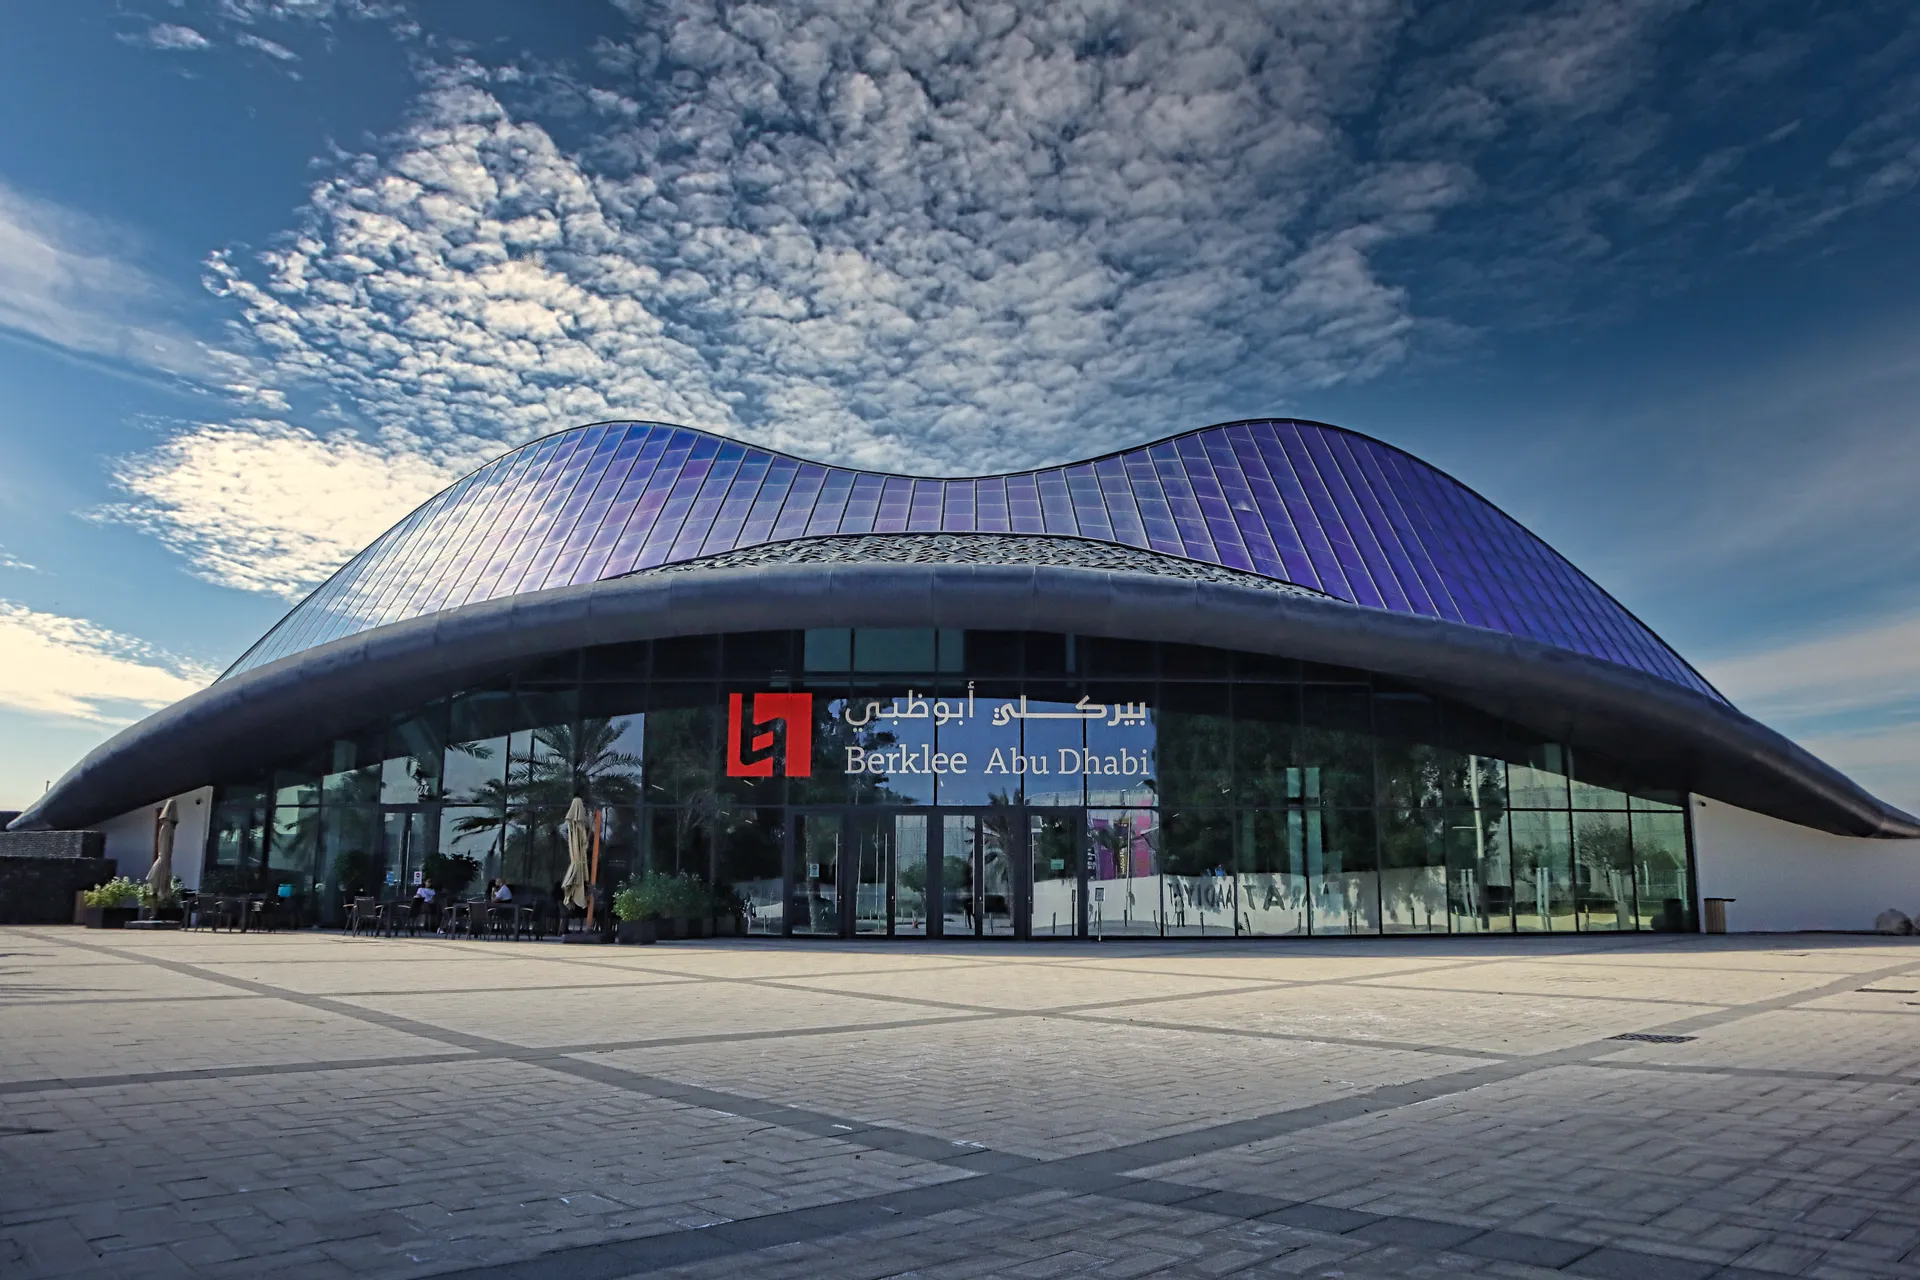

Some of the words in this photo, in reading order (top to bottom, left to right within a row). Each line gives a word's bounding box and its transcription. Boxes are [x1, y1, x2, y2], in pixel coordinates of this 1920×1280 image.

[845, 681, 974, 733] أبوظبي
[991, 695, 1146, 726] بيركلي
[844, 744, 968, 774] Berklee
[984, 748, 1050, 775] Abu
[1058, 748, 1150, 775] Dhabi
